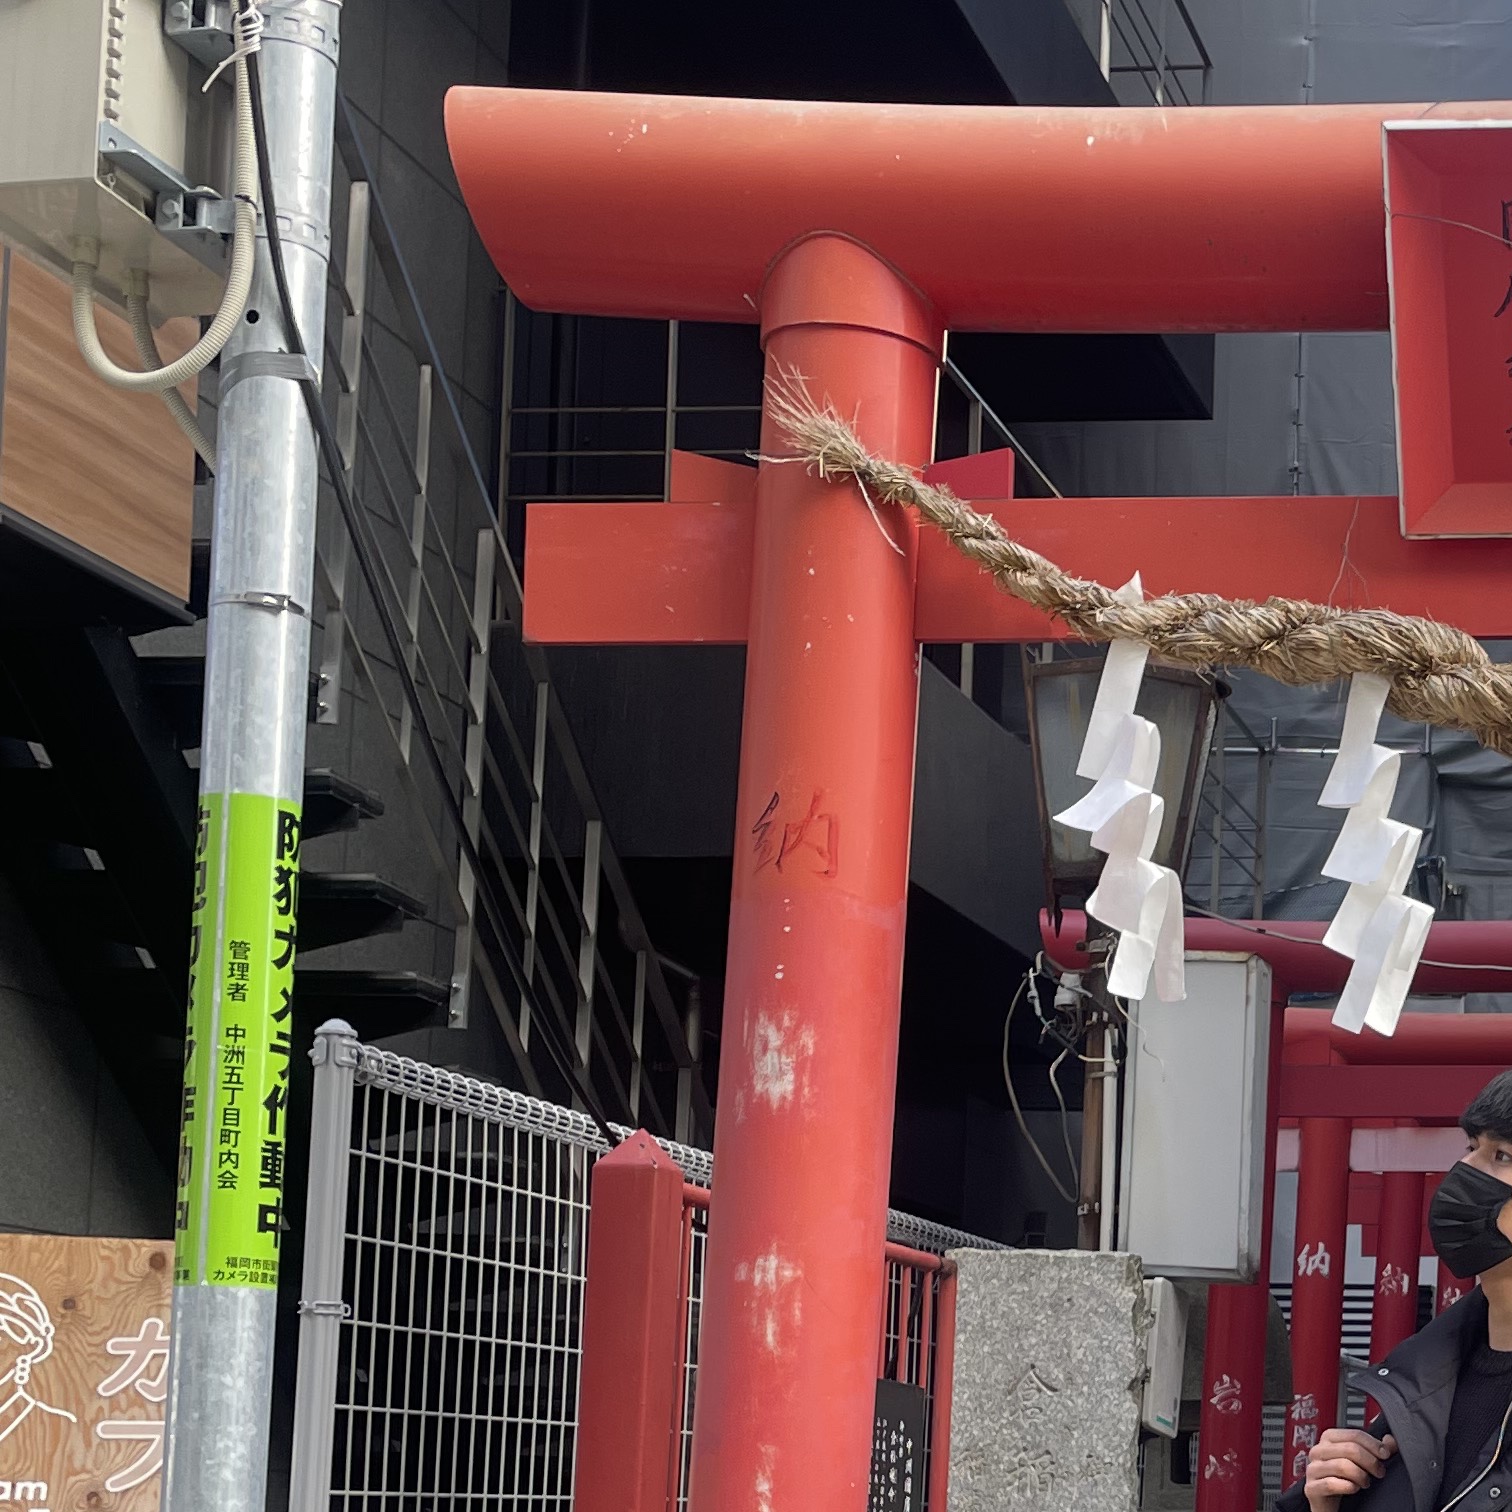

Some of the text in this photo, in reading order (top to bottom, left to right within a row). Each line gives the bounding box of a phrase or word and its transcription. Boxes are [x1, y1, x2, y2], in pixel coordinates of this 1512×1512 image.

[751, 790, 839, 878] 納
[217, 939, 251, 1190] 管理者 中洲五丁目町内会
[1297, 1241, 1331, 1278] 納
